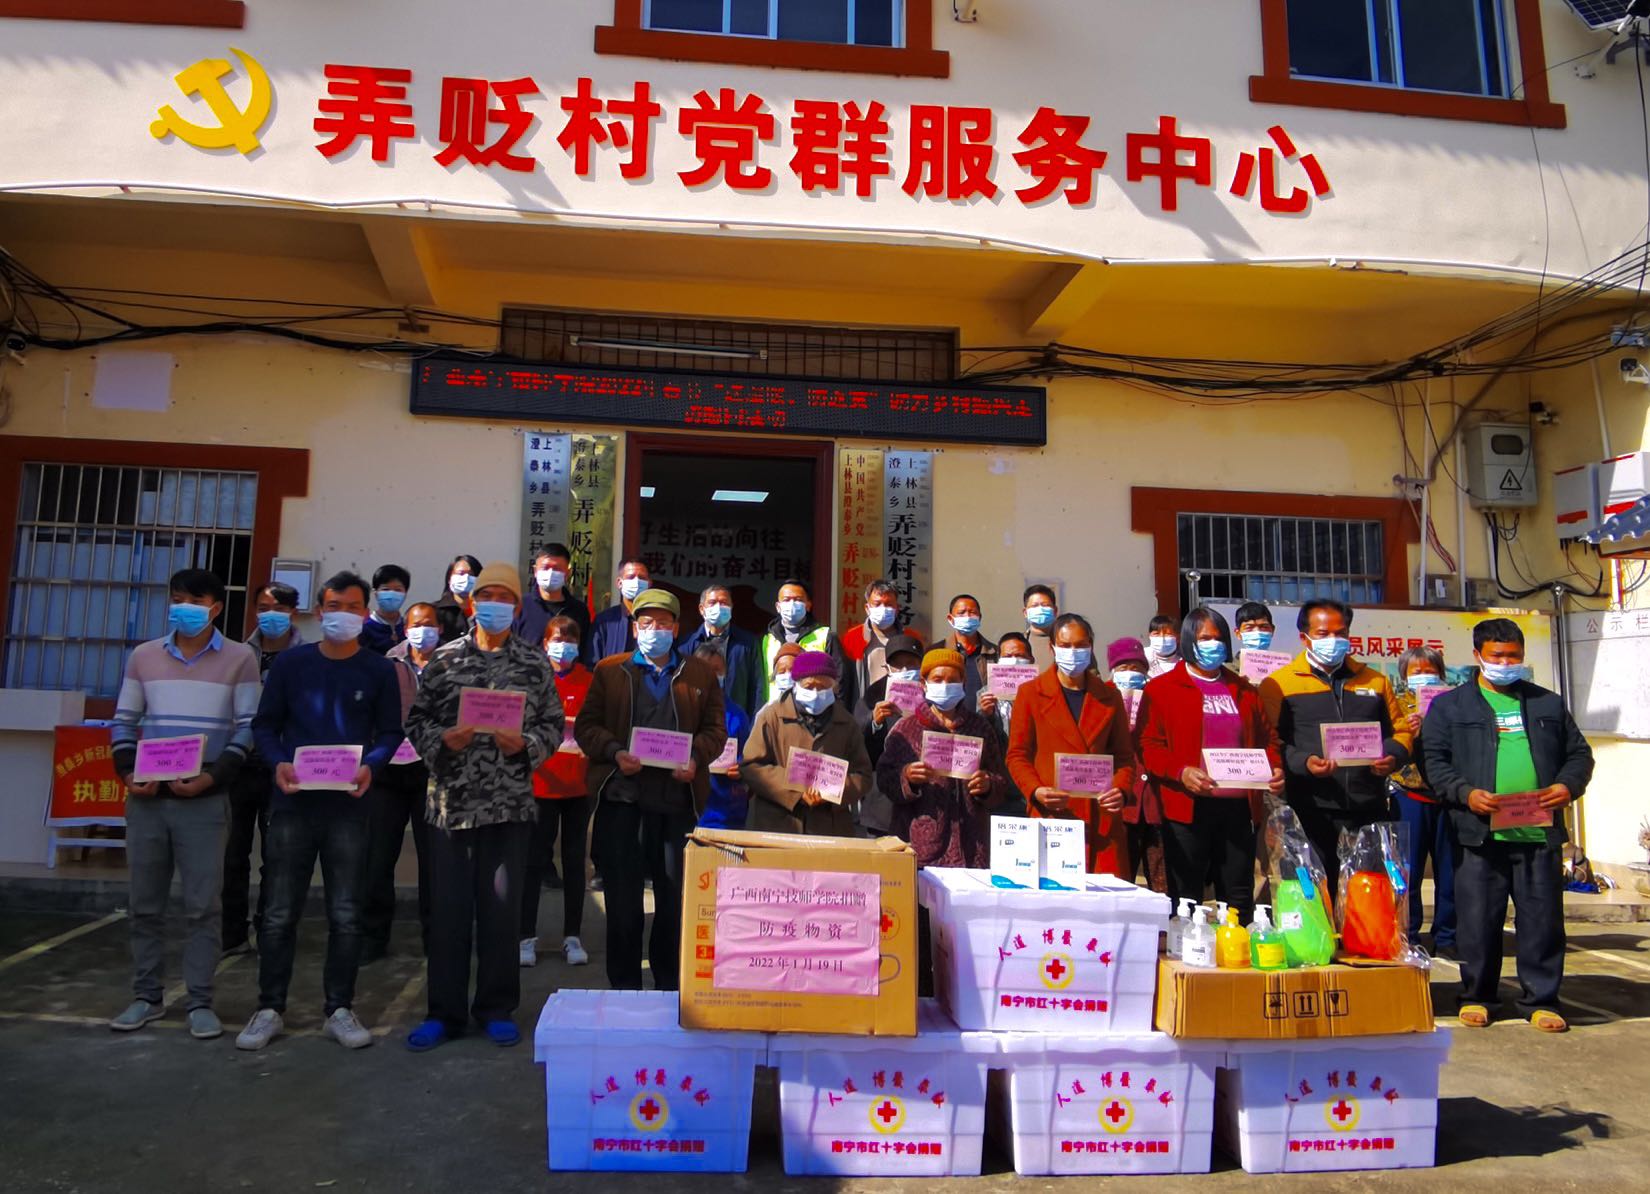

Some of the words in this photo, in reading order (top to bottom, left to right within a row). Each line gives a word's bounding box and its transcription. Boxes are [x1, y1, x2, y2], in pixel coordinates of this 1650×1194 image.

[313, 64, 1332, 213] 弄贬村党群服务中心
[759, 919, 843, 941] 防疫物资
